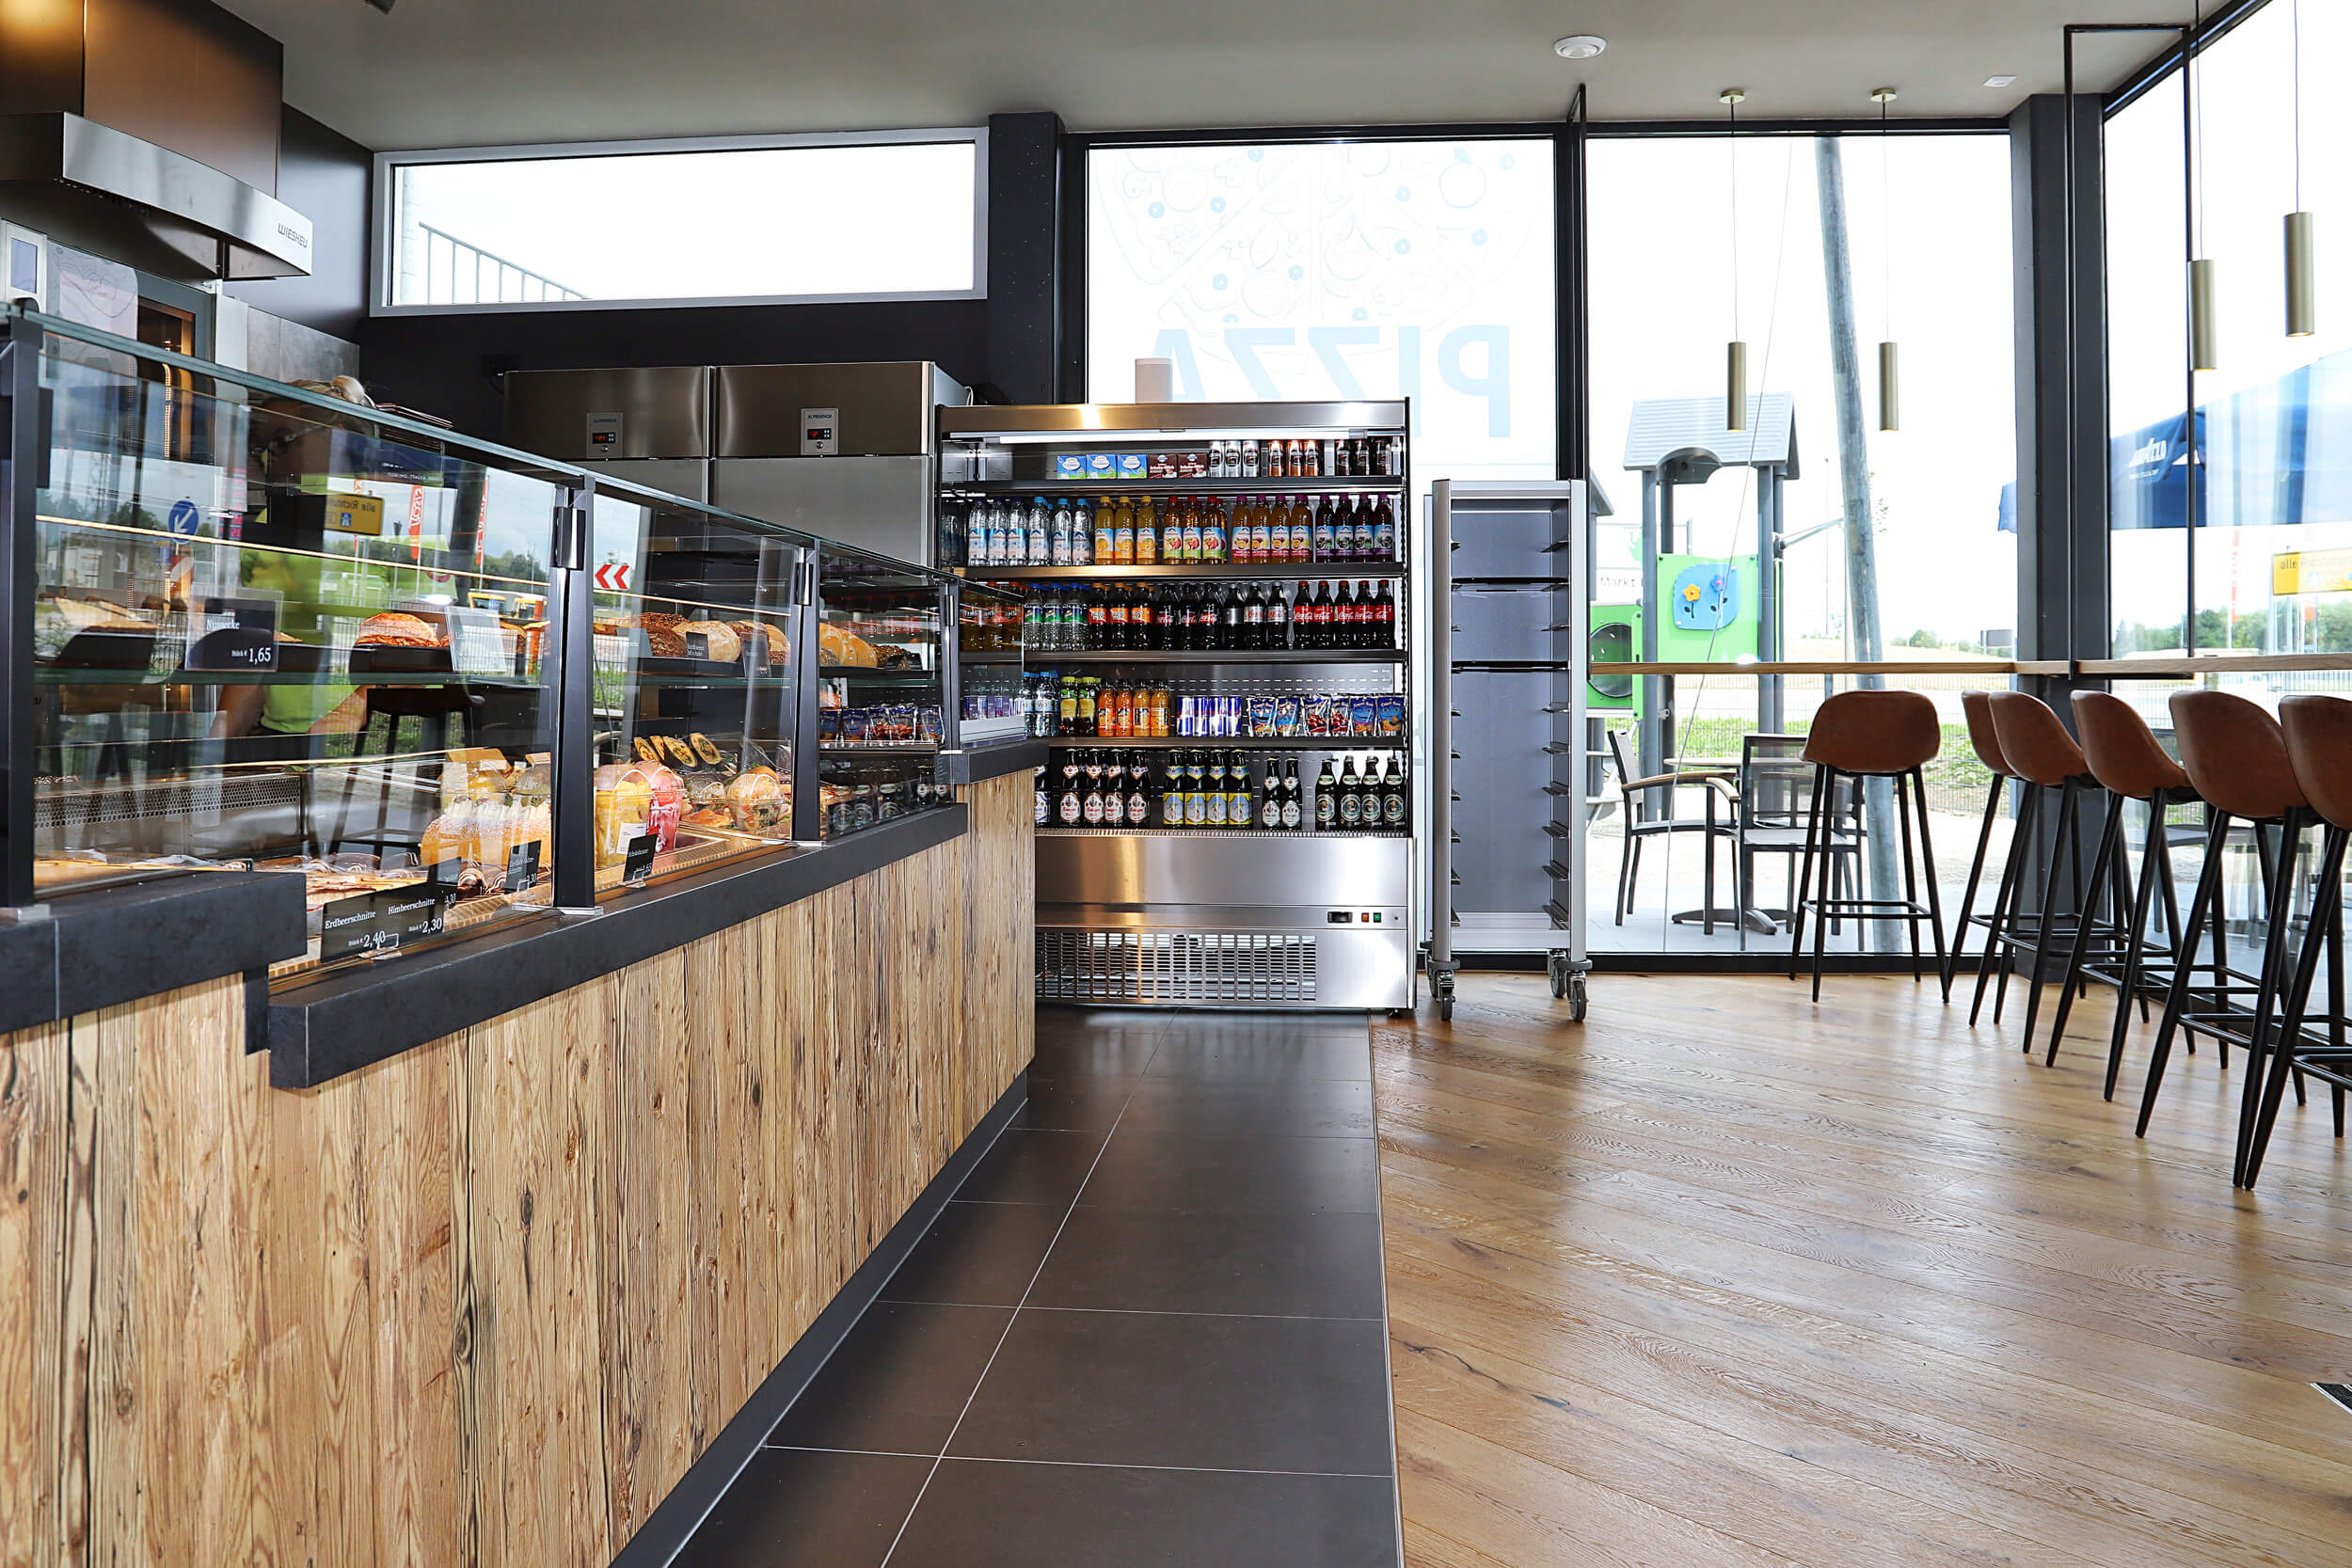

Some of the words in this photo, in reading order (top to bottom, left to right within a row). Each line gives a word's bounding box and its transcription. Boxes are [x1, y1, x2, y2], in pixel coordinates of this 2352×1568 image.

[278, 222, 309, 248] WIESHEU
[2280, 558, 2297, 570] alle
[1600, 576, 1637, 588] Markt
[249, 647, 272, 665] 1,65
[388, 898, 437, 915] Himbeerschnitte
[325, 911, 377, 929] Erdbeerschnitte
[421, 917, 443, 935] 2,30
[363, 930, 387, 948] 2,40
